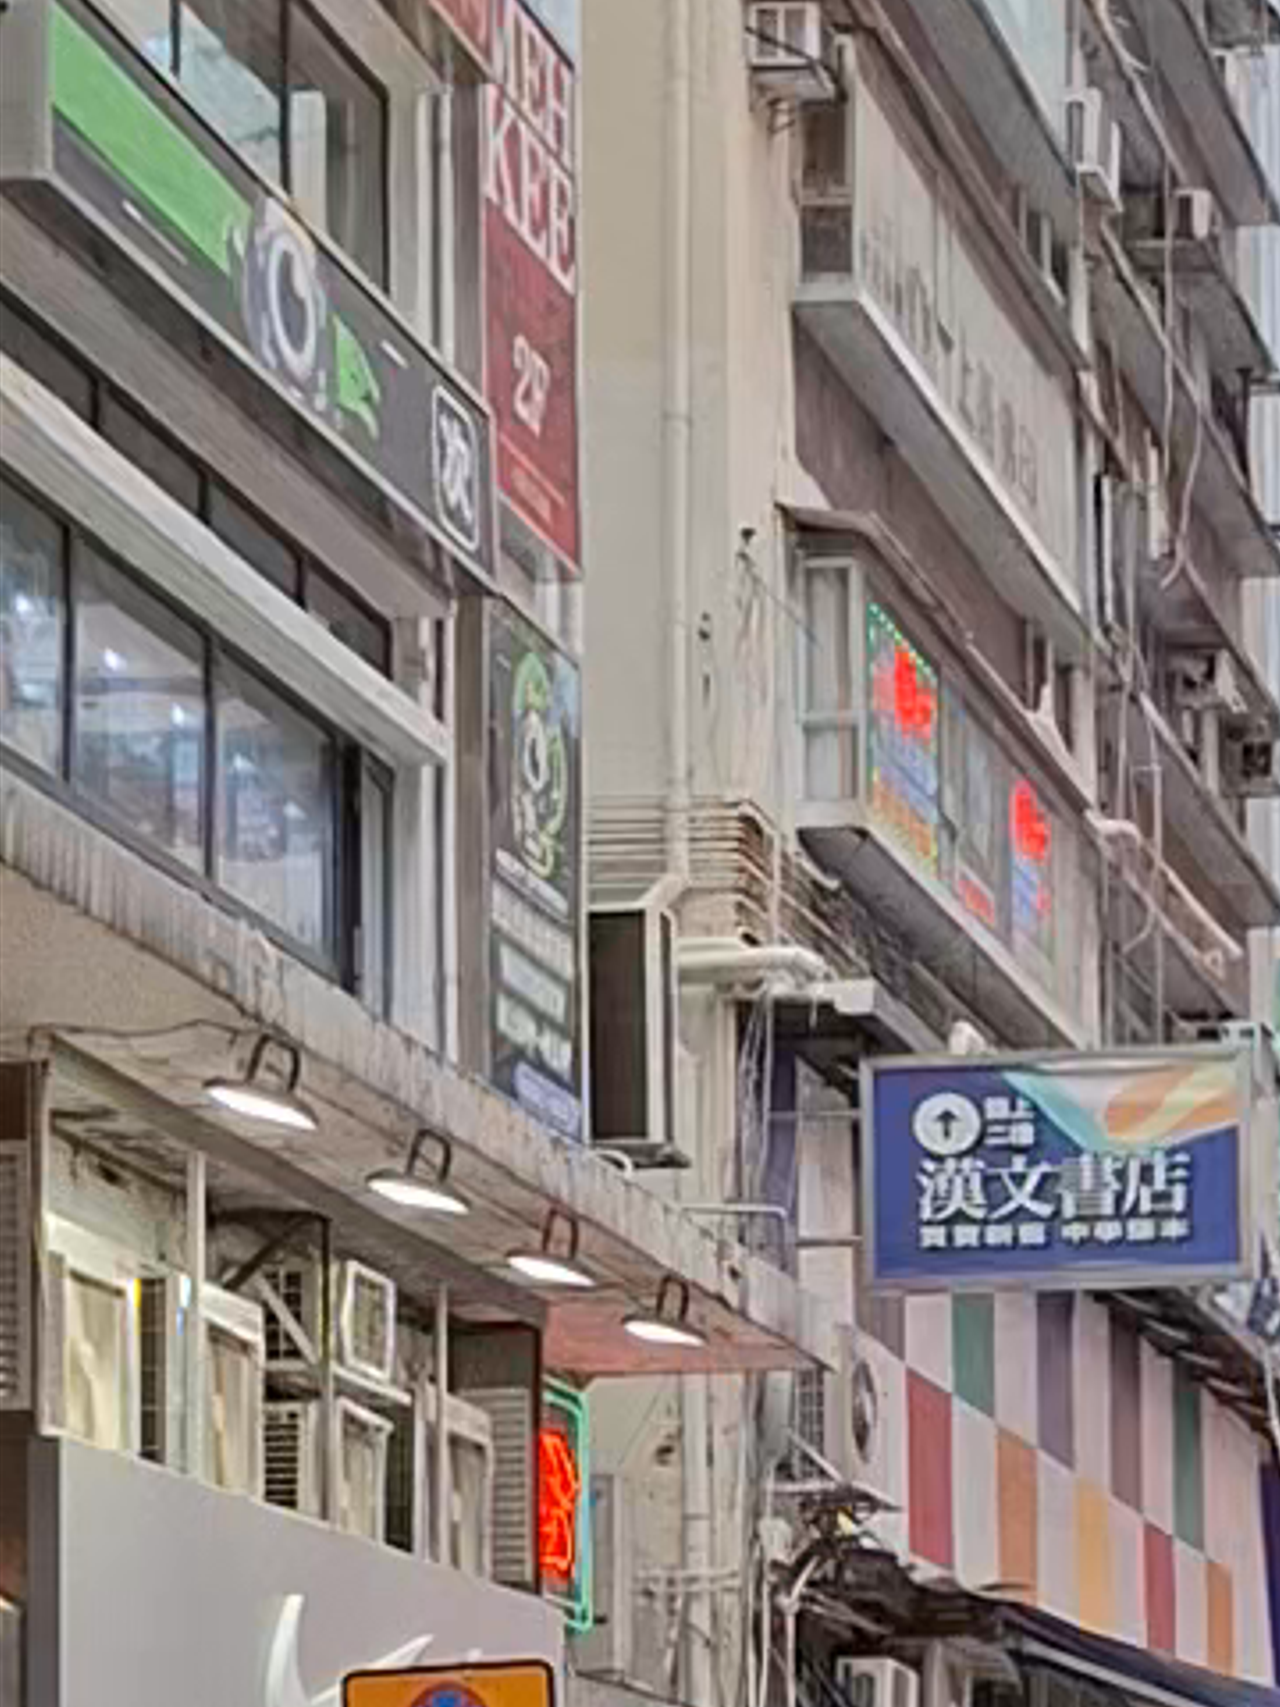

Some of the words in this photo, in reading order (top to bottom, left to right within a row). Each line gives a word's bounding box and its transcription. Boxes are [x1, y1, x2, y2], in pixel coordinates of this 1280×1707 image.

[488, 83, 574, 296] KEE
[916, 1153, 1191, 1221] 漢文書店
